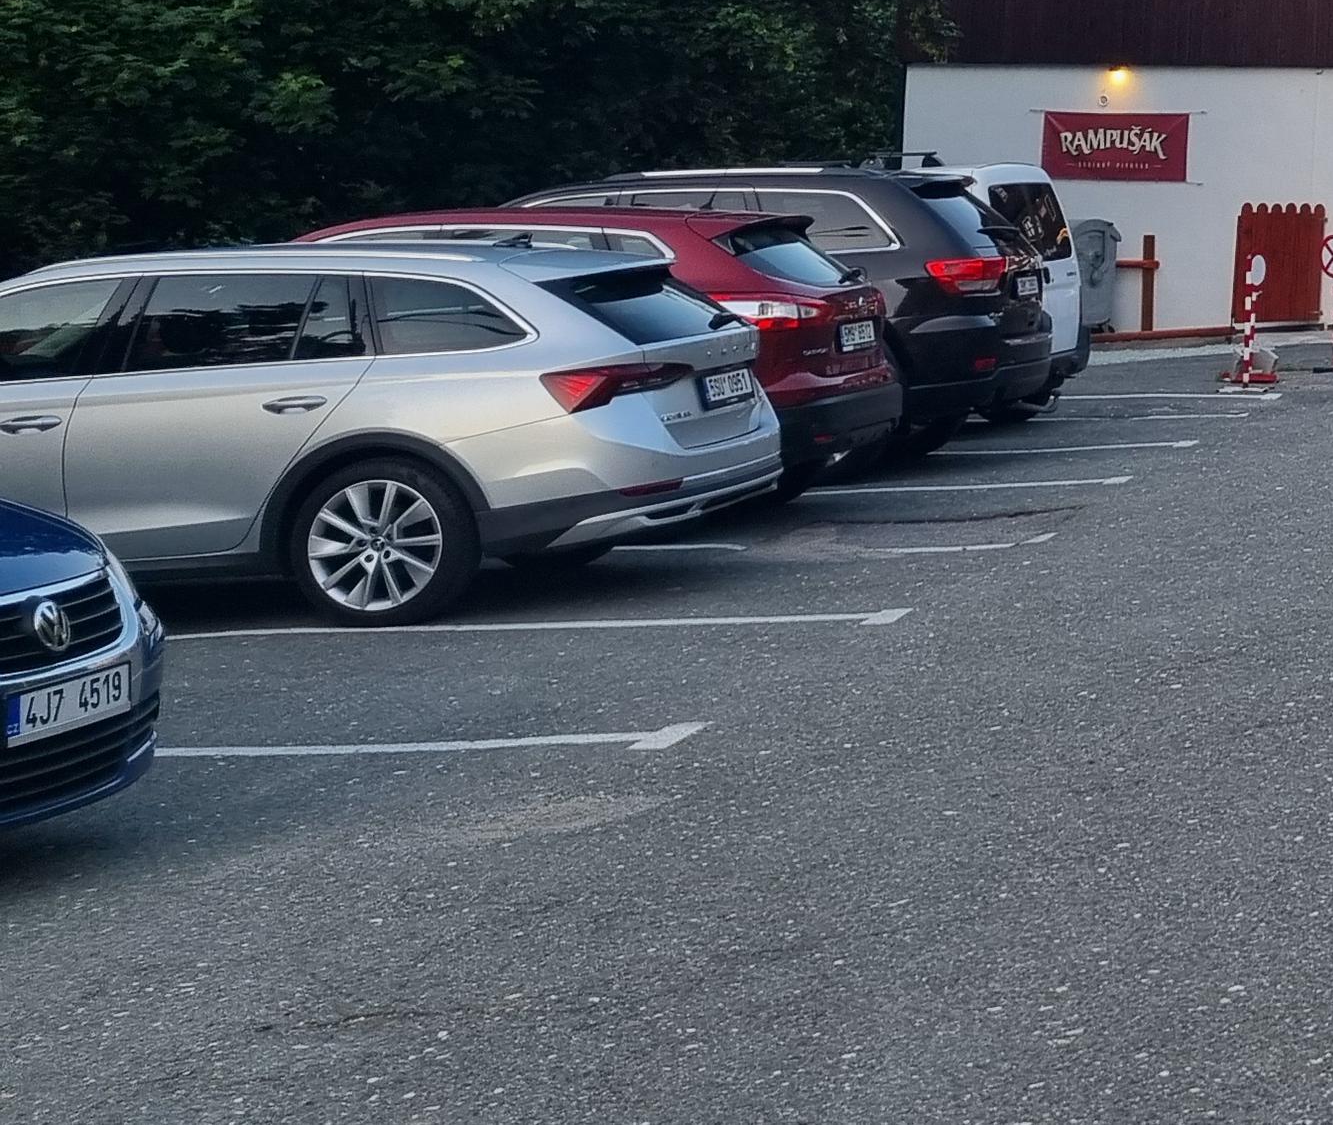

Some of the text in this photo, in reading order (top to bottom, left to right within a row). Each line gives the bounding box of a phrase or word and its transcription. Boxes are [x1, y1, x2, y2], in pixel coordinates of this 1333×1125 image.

[1060, 125, 1168, 159] RAMPUŠÁK
[26, 670, 122, 728] 4J7 4519
